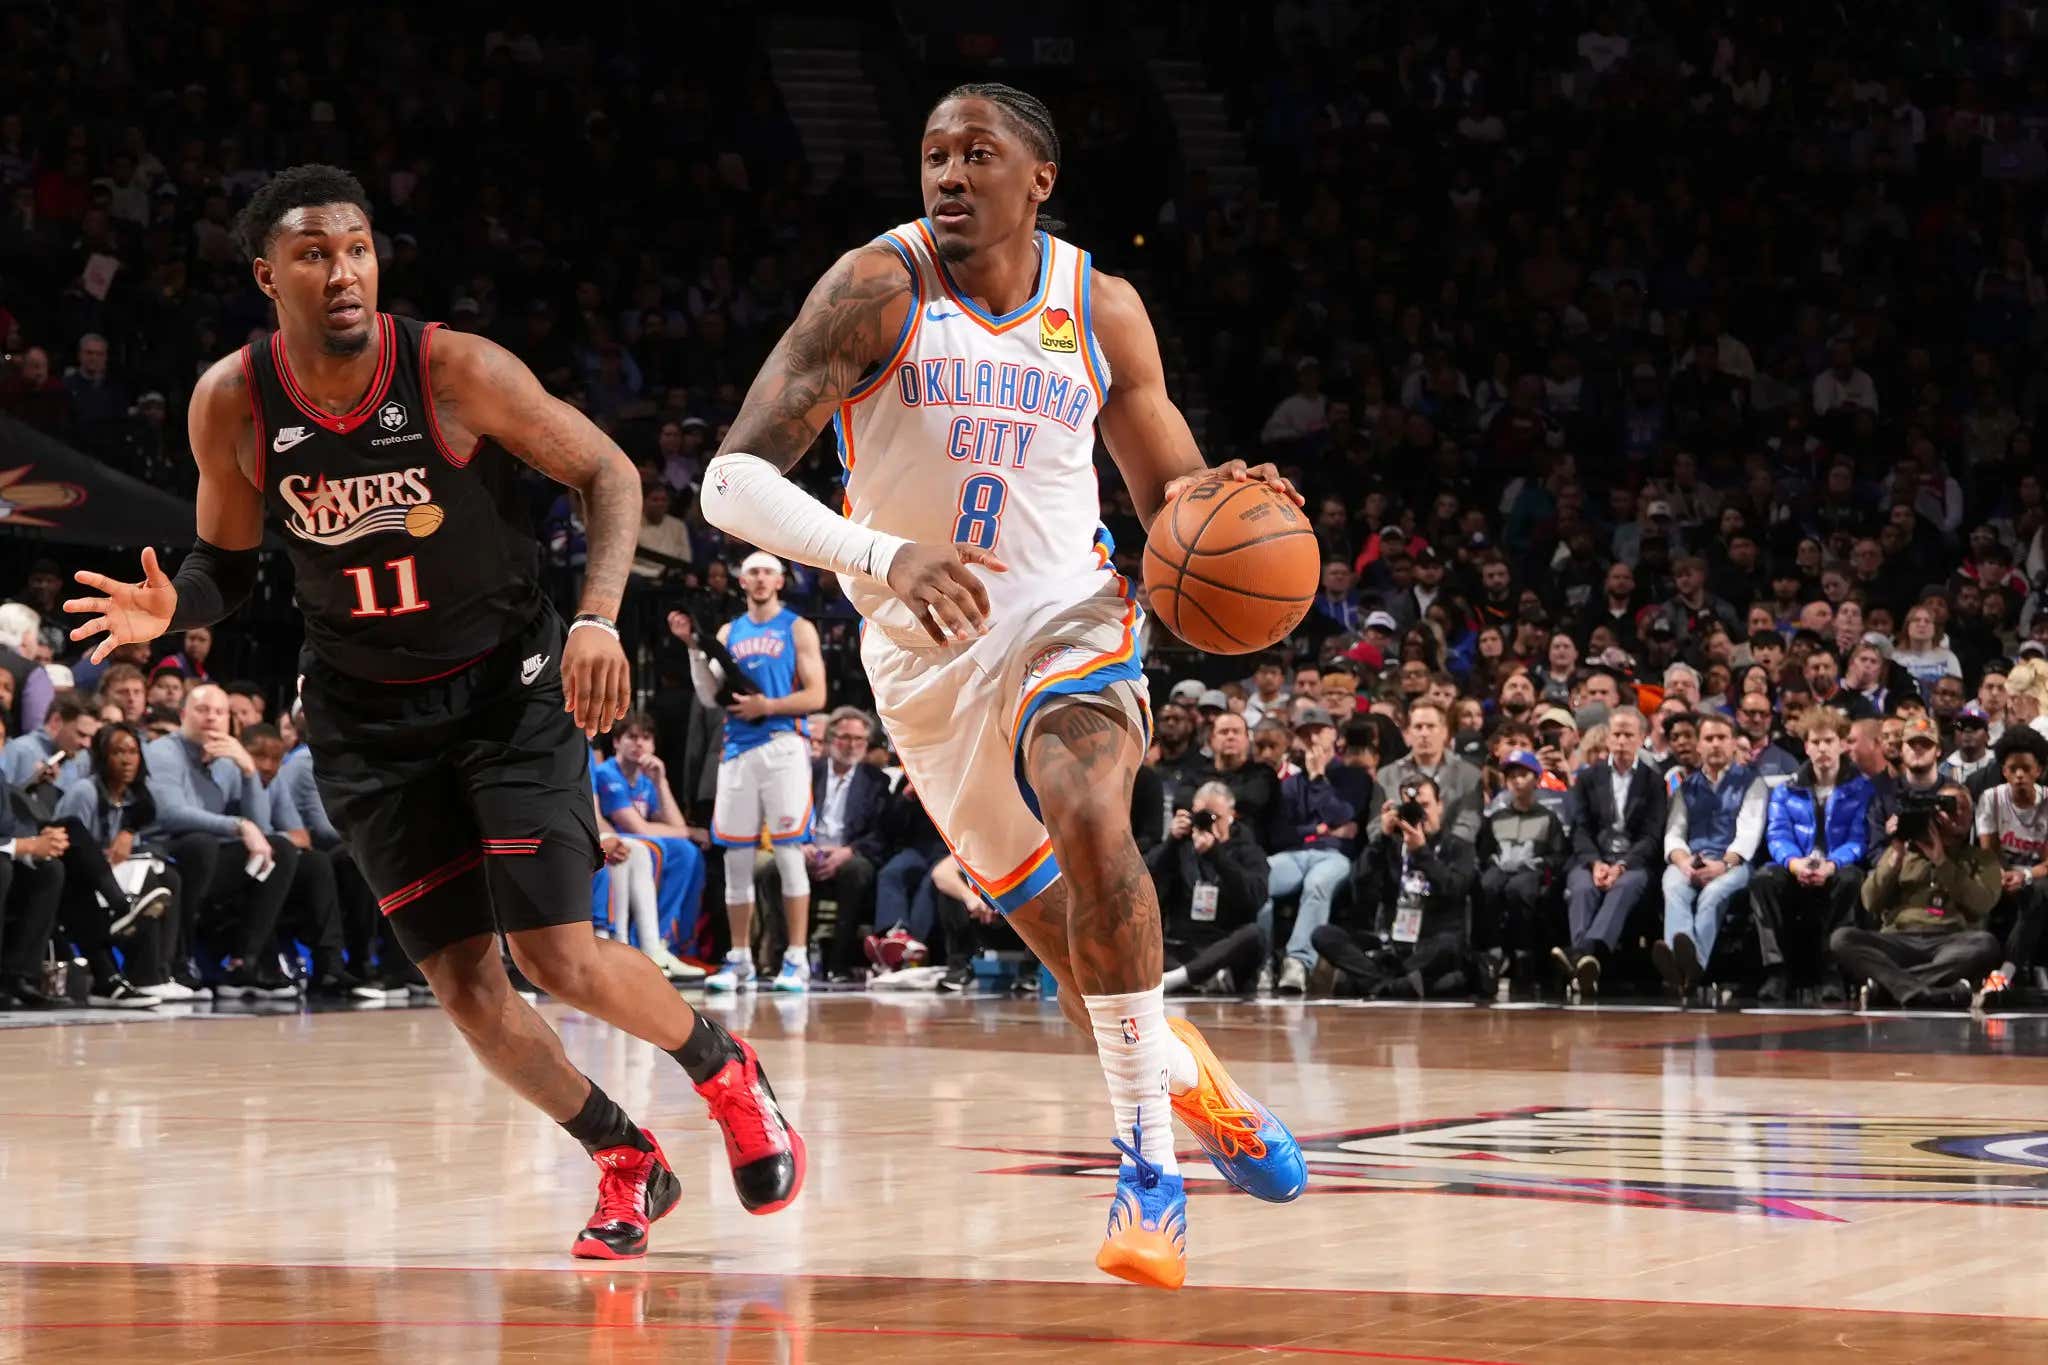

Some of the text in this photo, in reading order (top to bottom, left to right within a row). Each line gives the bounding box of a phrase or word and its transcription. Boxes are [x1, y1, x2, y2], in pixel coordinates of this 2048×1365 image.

[897, 358, 1092, 432] OKLAHOMA
[277, 426, 306, 443] NIKE
[371, 432, 423, 447] crypto.com
[947, 416, 1037, 468] CITY
[951, 473, 1008, 552] 8
[343, 554, 431, 618] 11
[522, 653, 544, 676] NIKE
